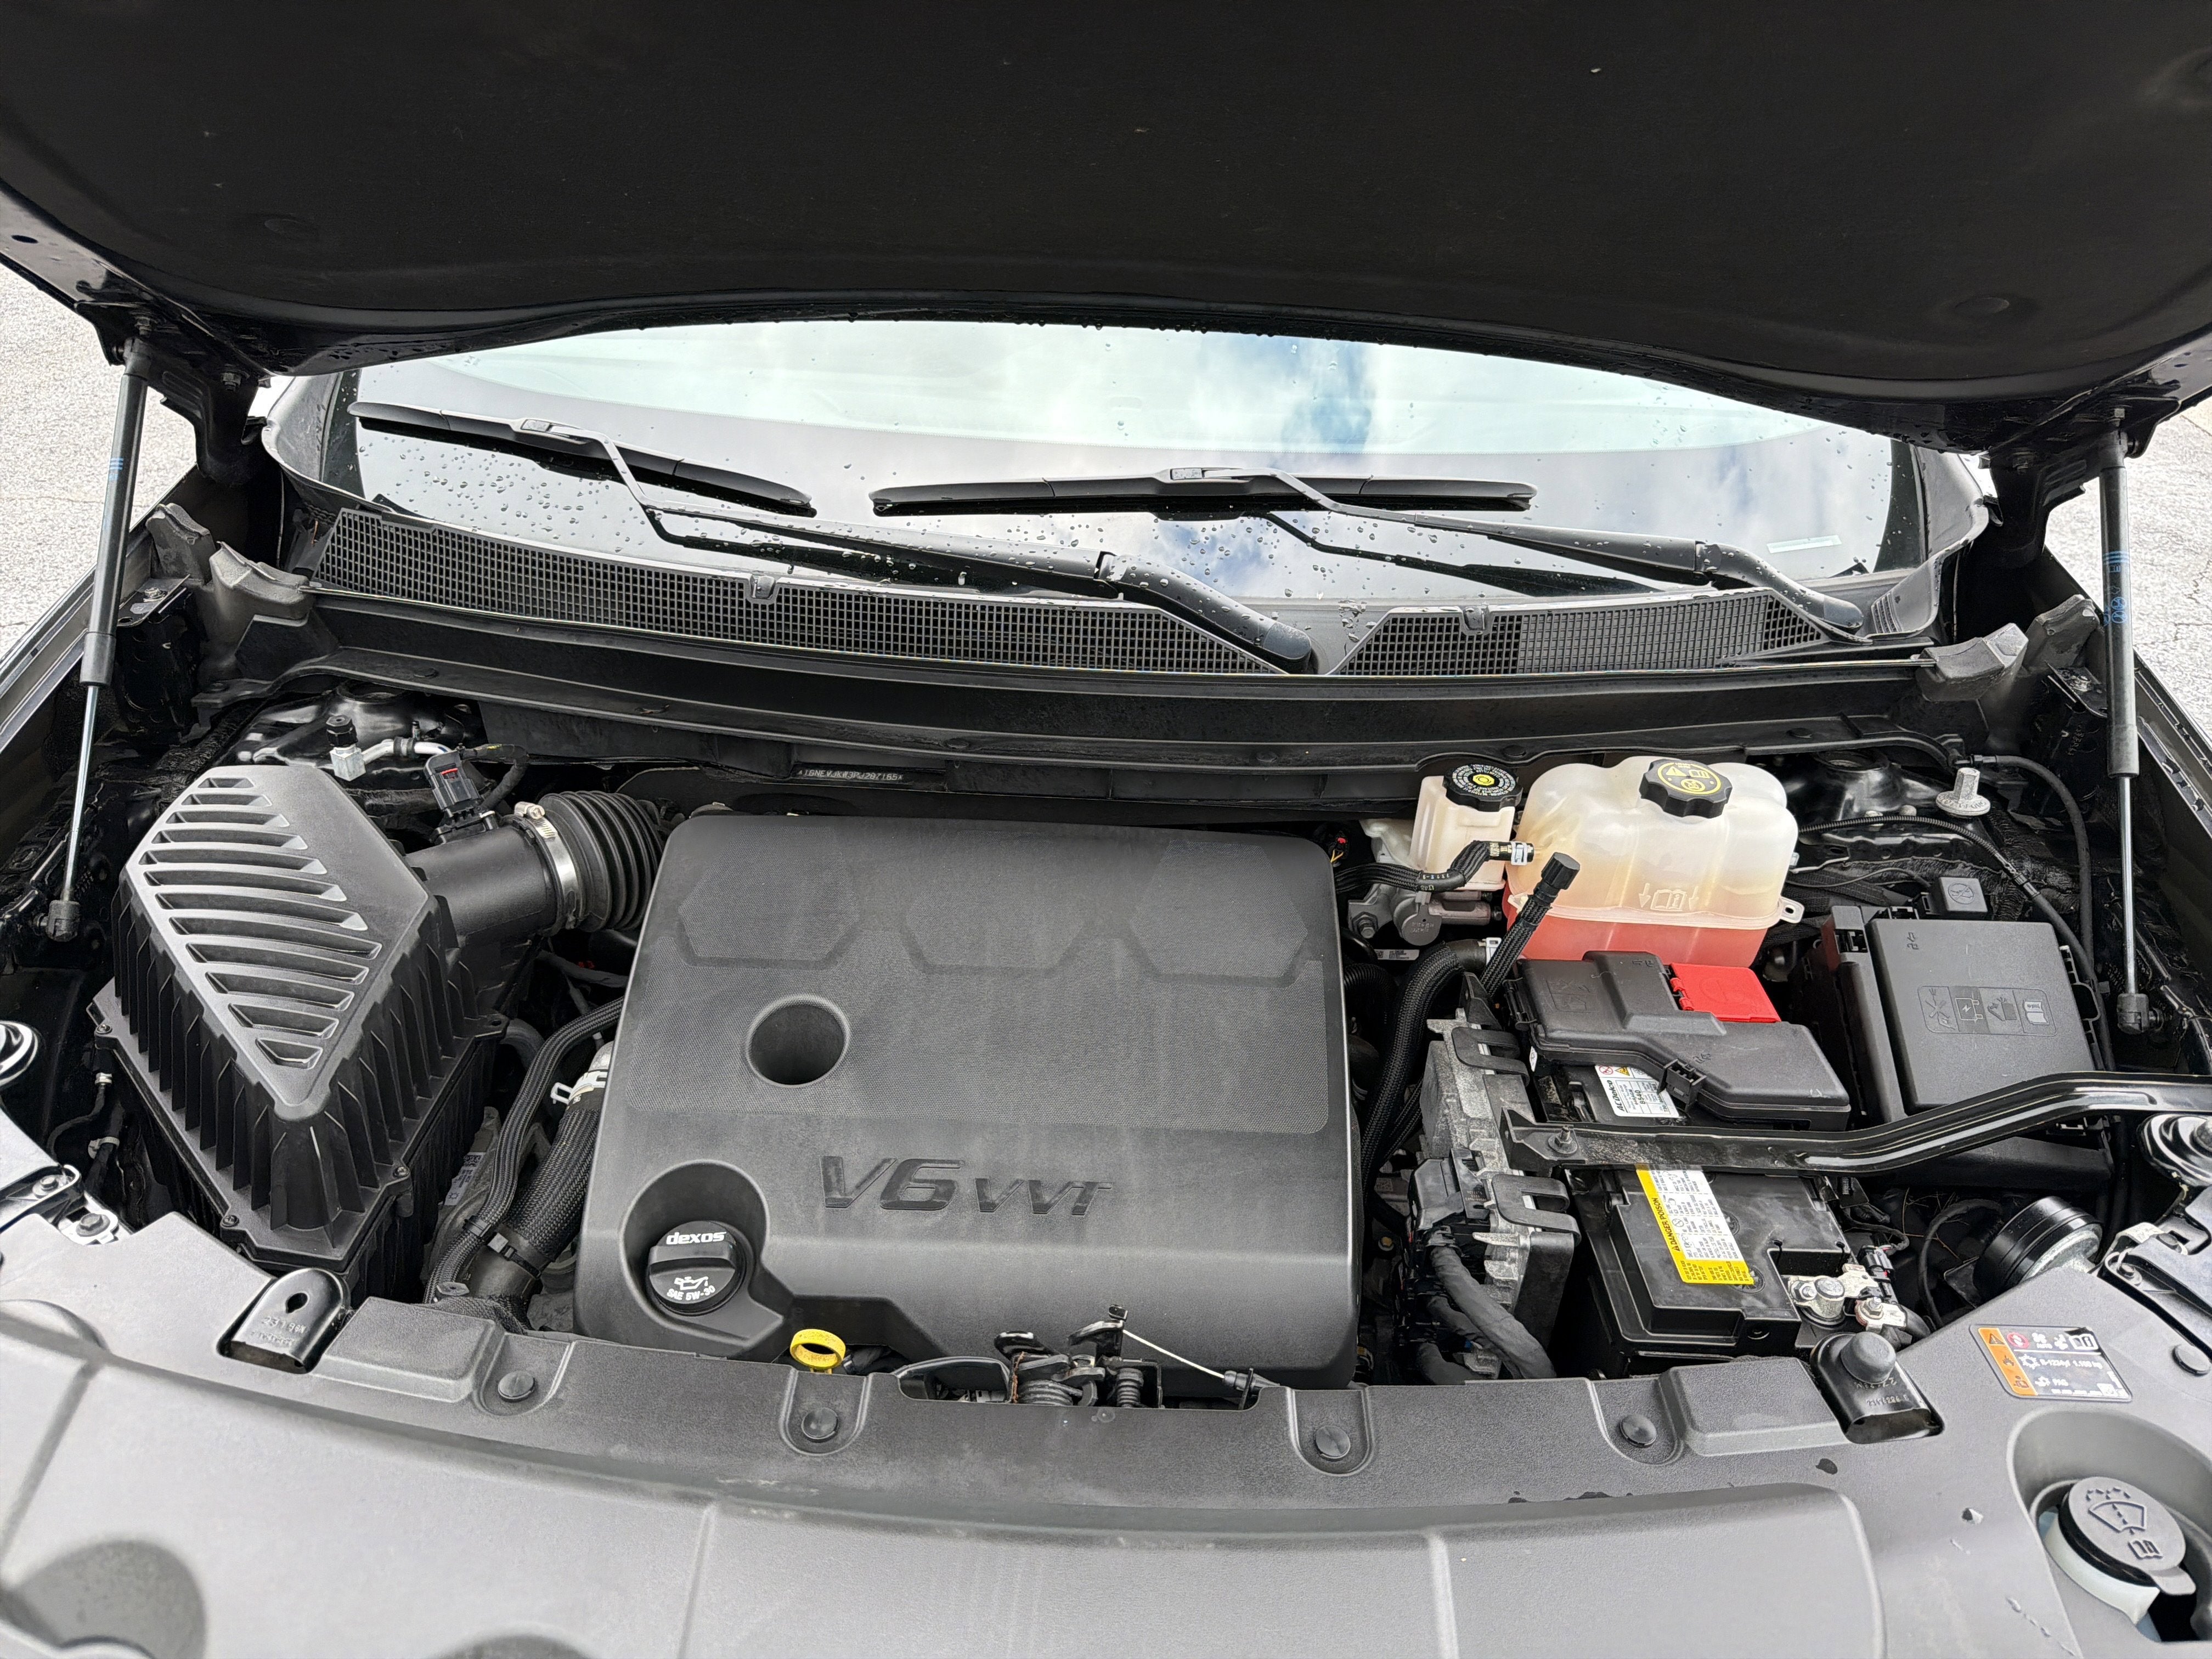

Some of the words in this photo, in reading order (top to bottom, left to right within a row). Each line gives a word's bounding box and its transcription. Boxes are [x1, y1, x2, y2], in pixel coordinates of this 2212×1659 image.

[1607, 1080, 1624, 1111] ACDelco
[819, 1155, 964, 1211] V6
[975, 1177, 1113, 1216] VVT
[666, 1232, 727, 1245] dexos
[667, 1288, 683, 1301] SAE
[686, 1285, 716, 1301] 5W-30
